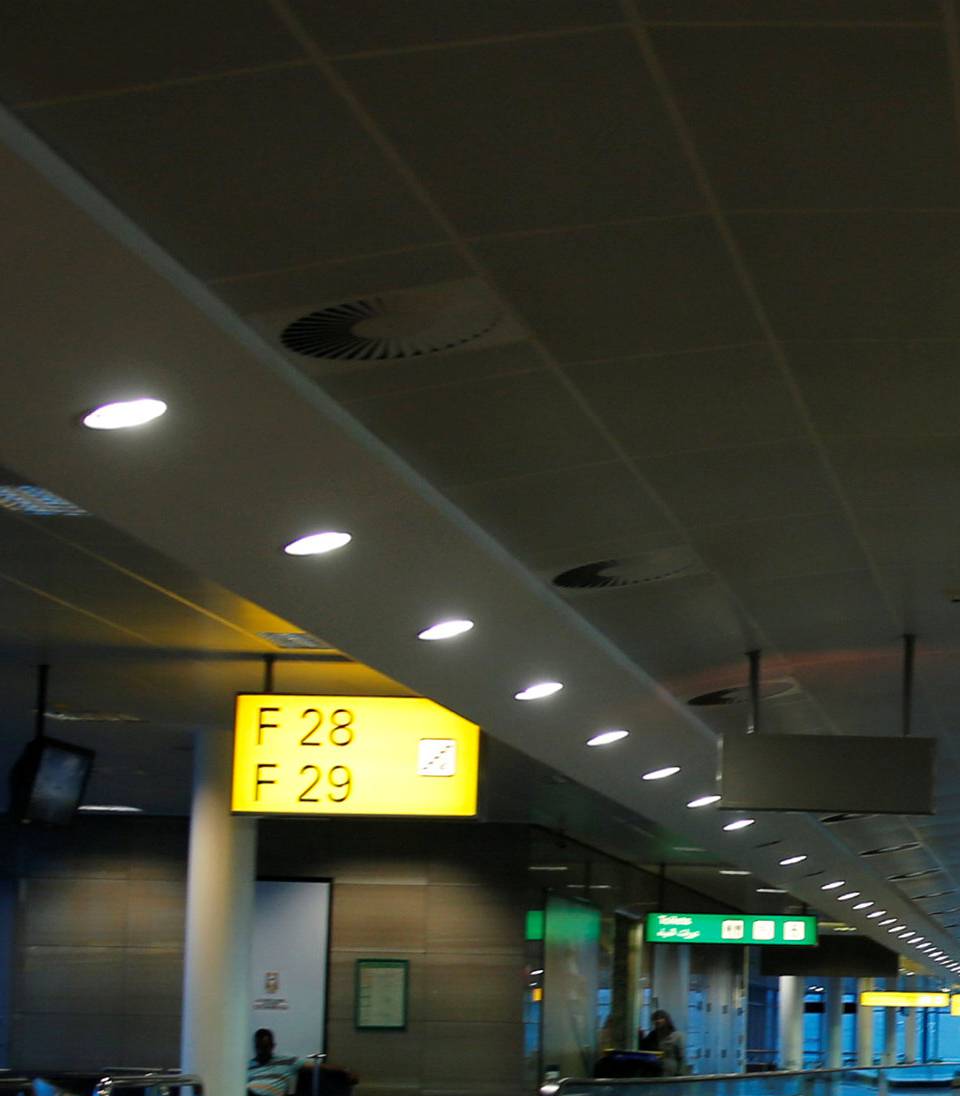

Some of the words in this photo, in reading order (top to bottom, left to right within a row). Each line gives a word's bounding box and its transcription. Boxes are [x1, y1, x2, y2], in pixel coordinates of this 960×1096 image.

[257, 707, 281, 746] F
[300, 707, 354, 747] 28
[255, 763, 278, 802] F
[298, 764, 352, 803] 29
